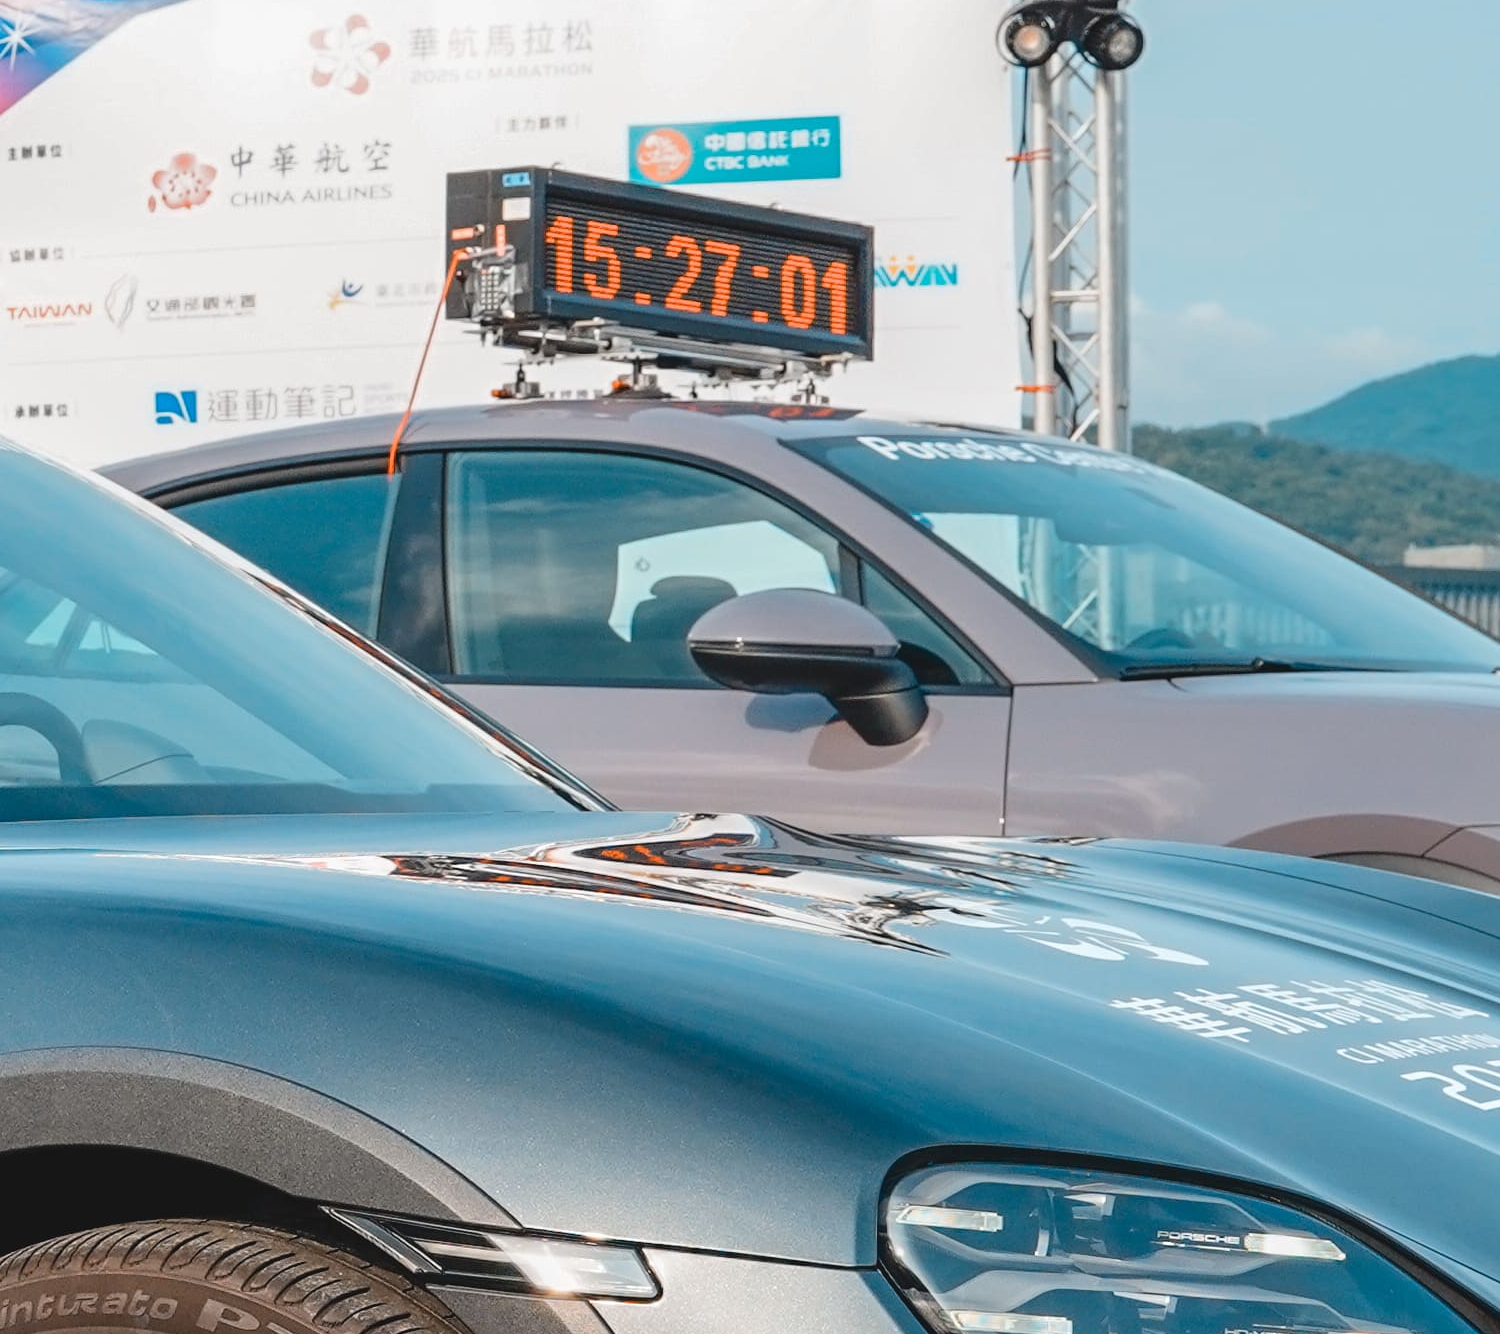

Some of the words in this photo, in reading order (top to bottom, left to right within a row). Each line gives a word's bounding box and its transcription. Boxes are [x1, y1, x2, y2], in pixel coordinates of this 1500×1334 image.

[408, 19, 594, 60] 華航馬拉松
[487, 62, 593, 78] MARATHON
[230, 138, 393, 178] 中華航空
[703, 155, 745, 171] CTBC
[746, 154, 789, 169] BANK
[230, 190, 295, 208] CHINA
[302, 183, 393, 203] AIRLINES
[544, 215, 849, 335] 15:27:01
[7, 302, 93, 321] TAIWAN
[207, 383, 358, 423] 運動筆記
[856, 436, 1038, 463] Porsche
[1109, 979, 1489, 1043] 華航馬拉松
[1336, 1047, 1384, 1064] CI
[1157, 1230, 1240, 1245] PORSCHE
